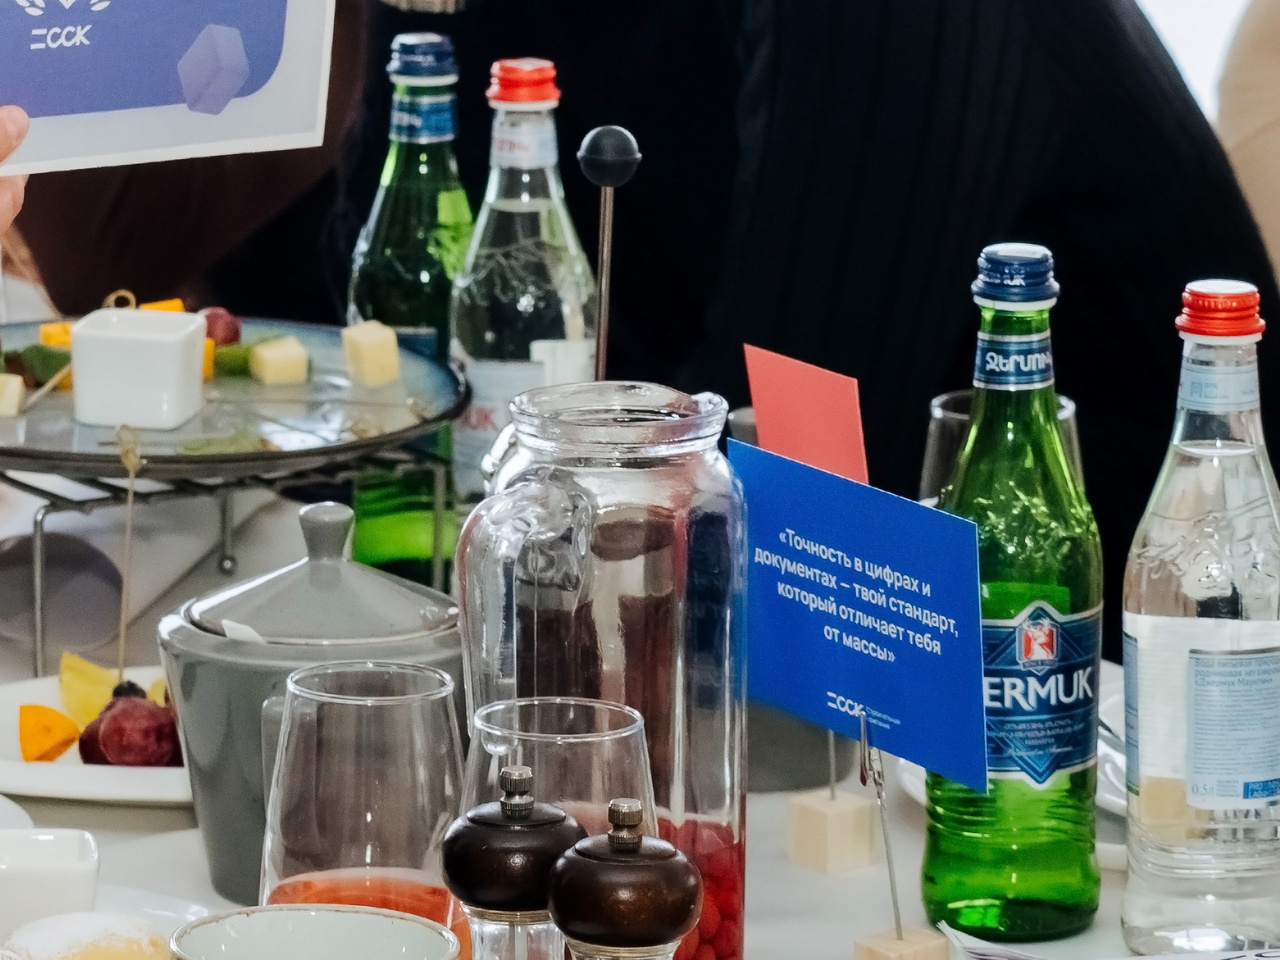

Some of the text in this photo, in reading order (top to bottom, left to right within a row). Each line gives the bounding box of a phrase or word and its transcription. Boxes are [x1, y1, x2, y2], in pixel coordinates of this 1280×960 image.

[754, 547, 837, 589] документах
[853, 582, 887, 608] твой
[889, 597, 959, 637] стандарт,
[779, 528, 931, 598] «Точность в цифрах и
[777, 581, 941, 655] который отличает тебя
[823, 625, 896, 663] от массы»
[983, 666, 1094, 712] ERMUK
